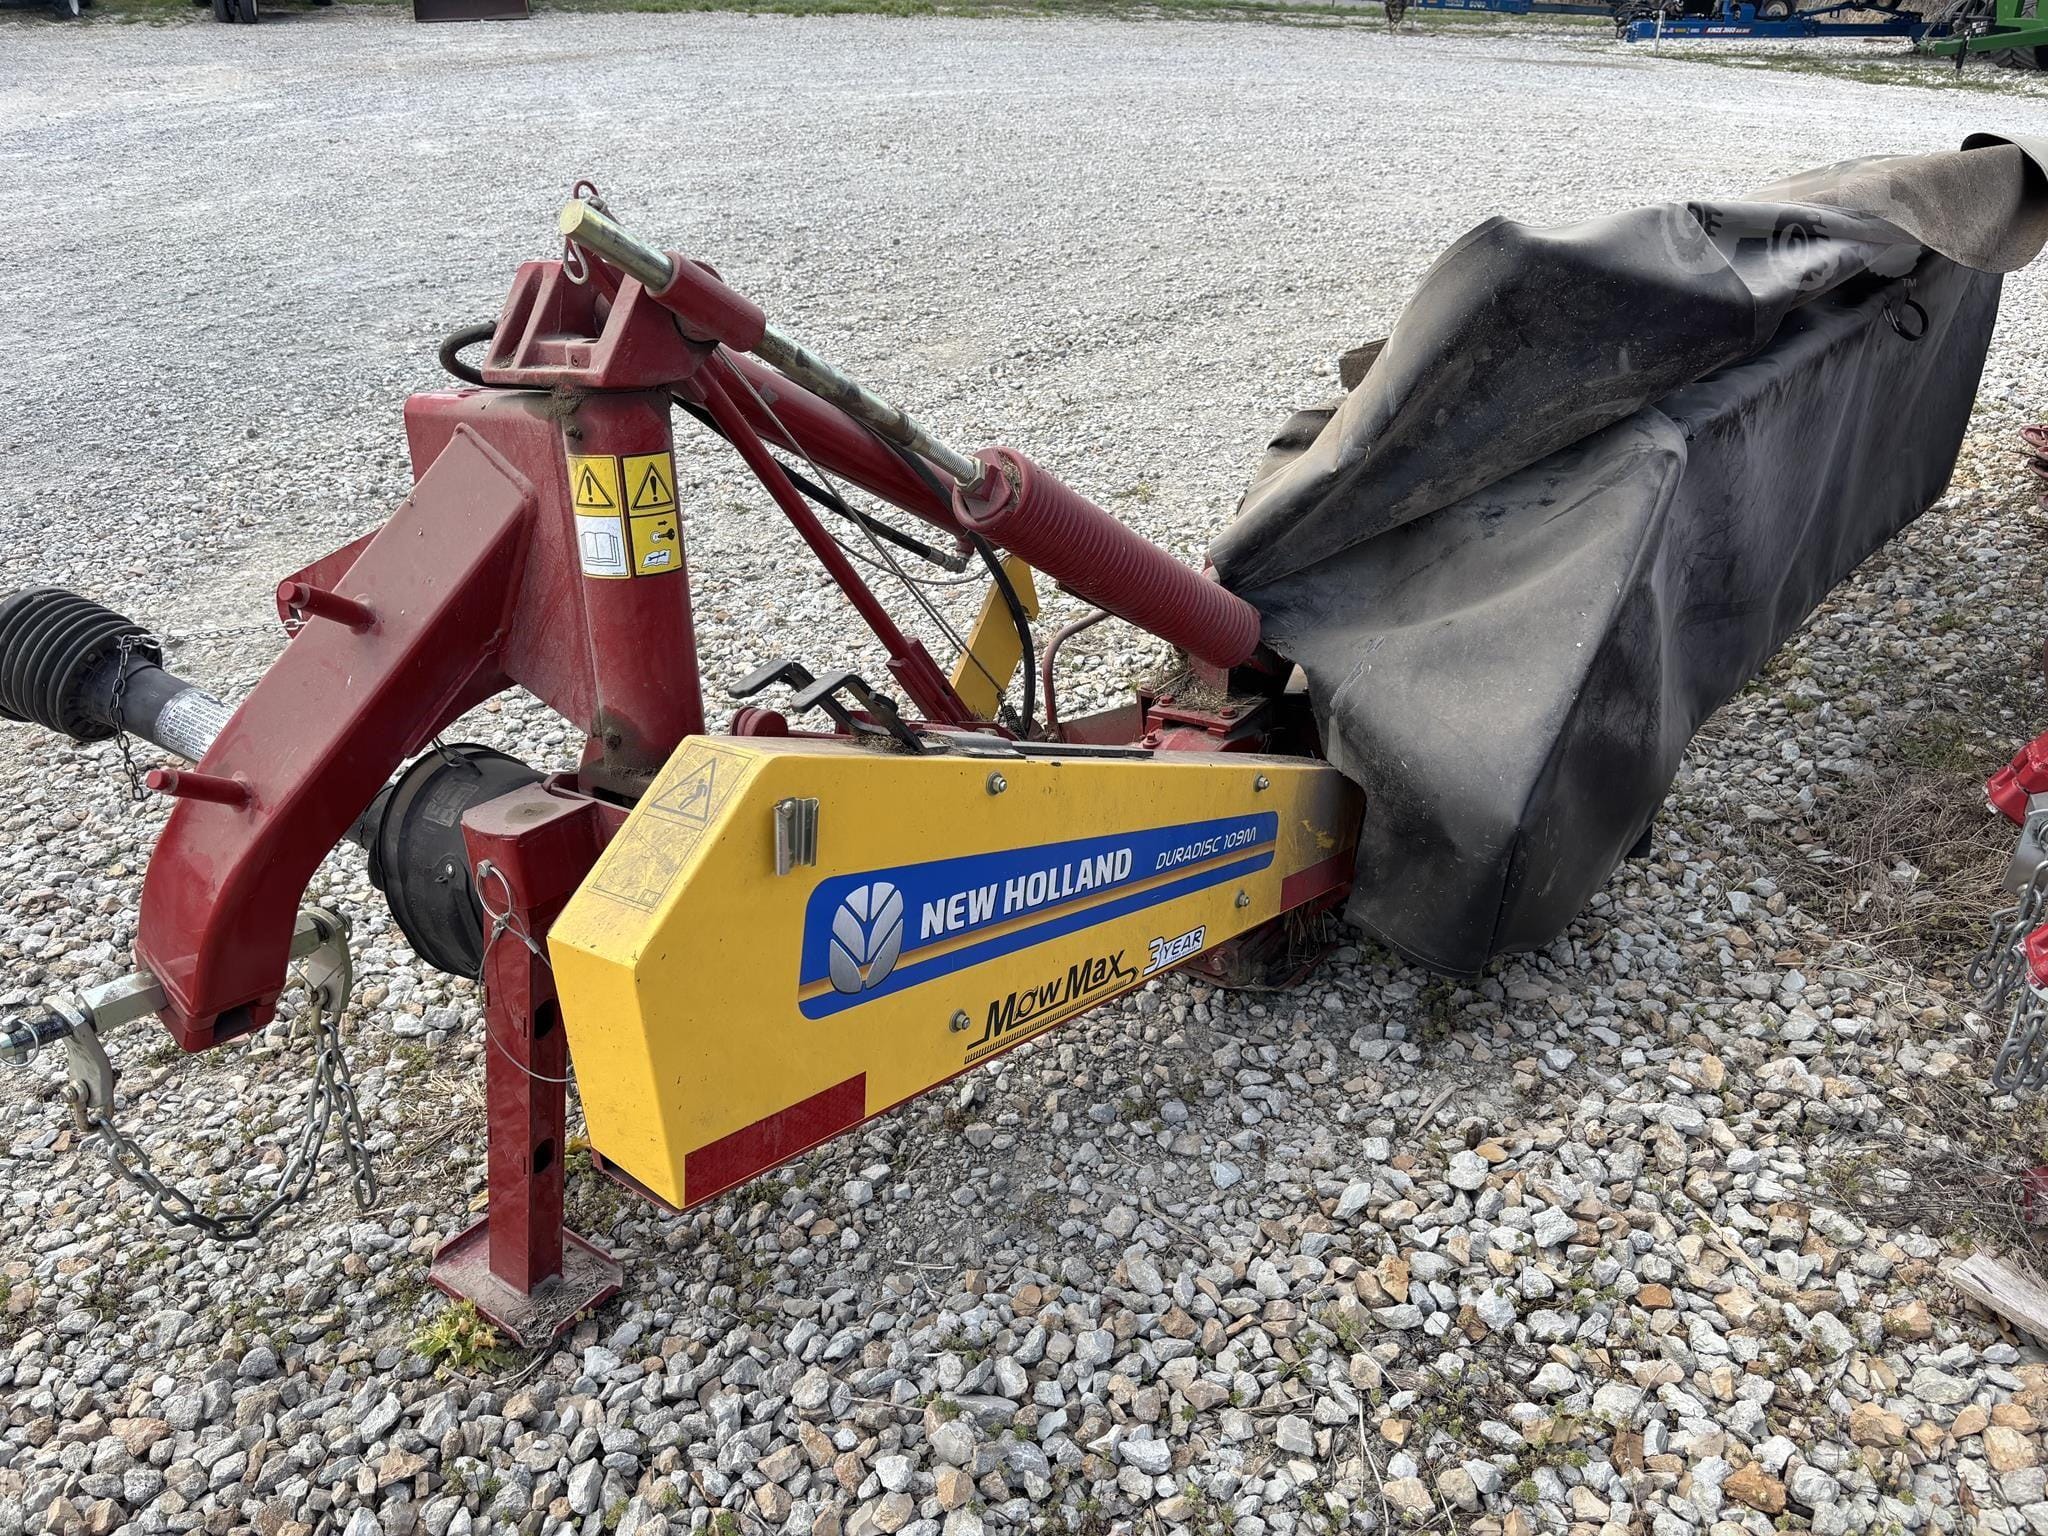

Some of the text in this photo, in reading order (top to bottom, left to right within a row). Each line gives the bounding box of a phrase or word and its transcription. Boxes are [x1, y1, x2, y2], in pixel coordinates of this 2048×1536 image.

[1155, 826, 1257, 870] DURADISC 109M
[920, 847, 1133, 940] NEW HOLLAND
[1163, 930, 1202, 959] YEAR
